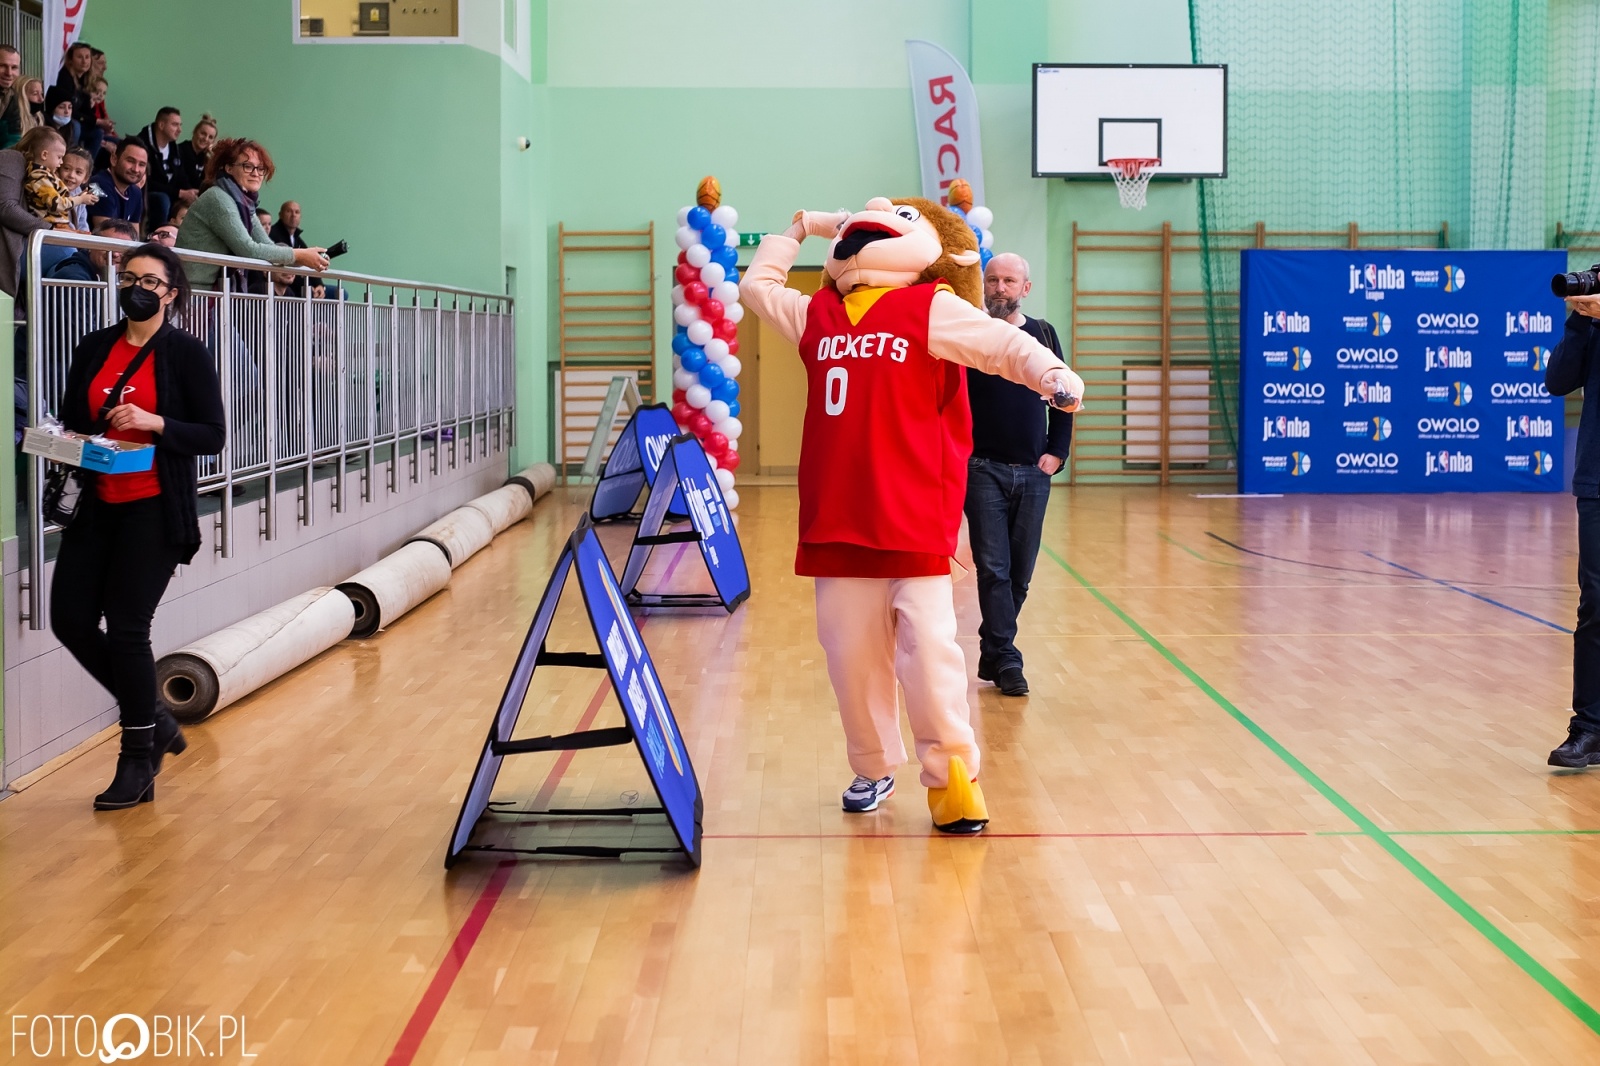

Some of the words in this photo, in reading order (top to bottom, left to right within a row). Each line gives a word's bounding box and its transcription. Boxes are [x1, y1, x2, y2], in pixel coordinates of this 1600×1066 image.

[1378, 265, 1404, 289] nba
[1287, 312, 1310, 332] nba
[1417, 313, 1479, 328] OWQLO
[1529, 312, 1552, 332] nba
[817, 332, 909, 363] OCKETS
[1337, 348, 1398, 362] OWQLO
[1449, 347, 1471, 368] nba
[1263, 383, 1325, 397] OWQLO
[1368, 382, 1391, 403] nba
[1287, 417, 1310, 437] nba
[1418, 418, 1479, 432] OWQLO
[1530, 416, 1552, 437] nba
[1336, 453, 1398, 467] OWQLO
[1450, 451, 1472, 472] nba
